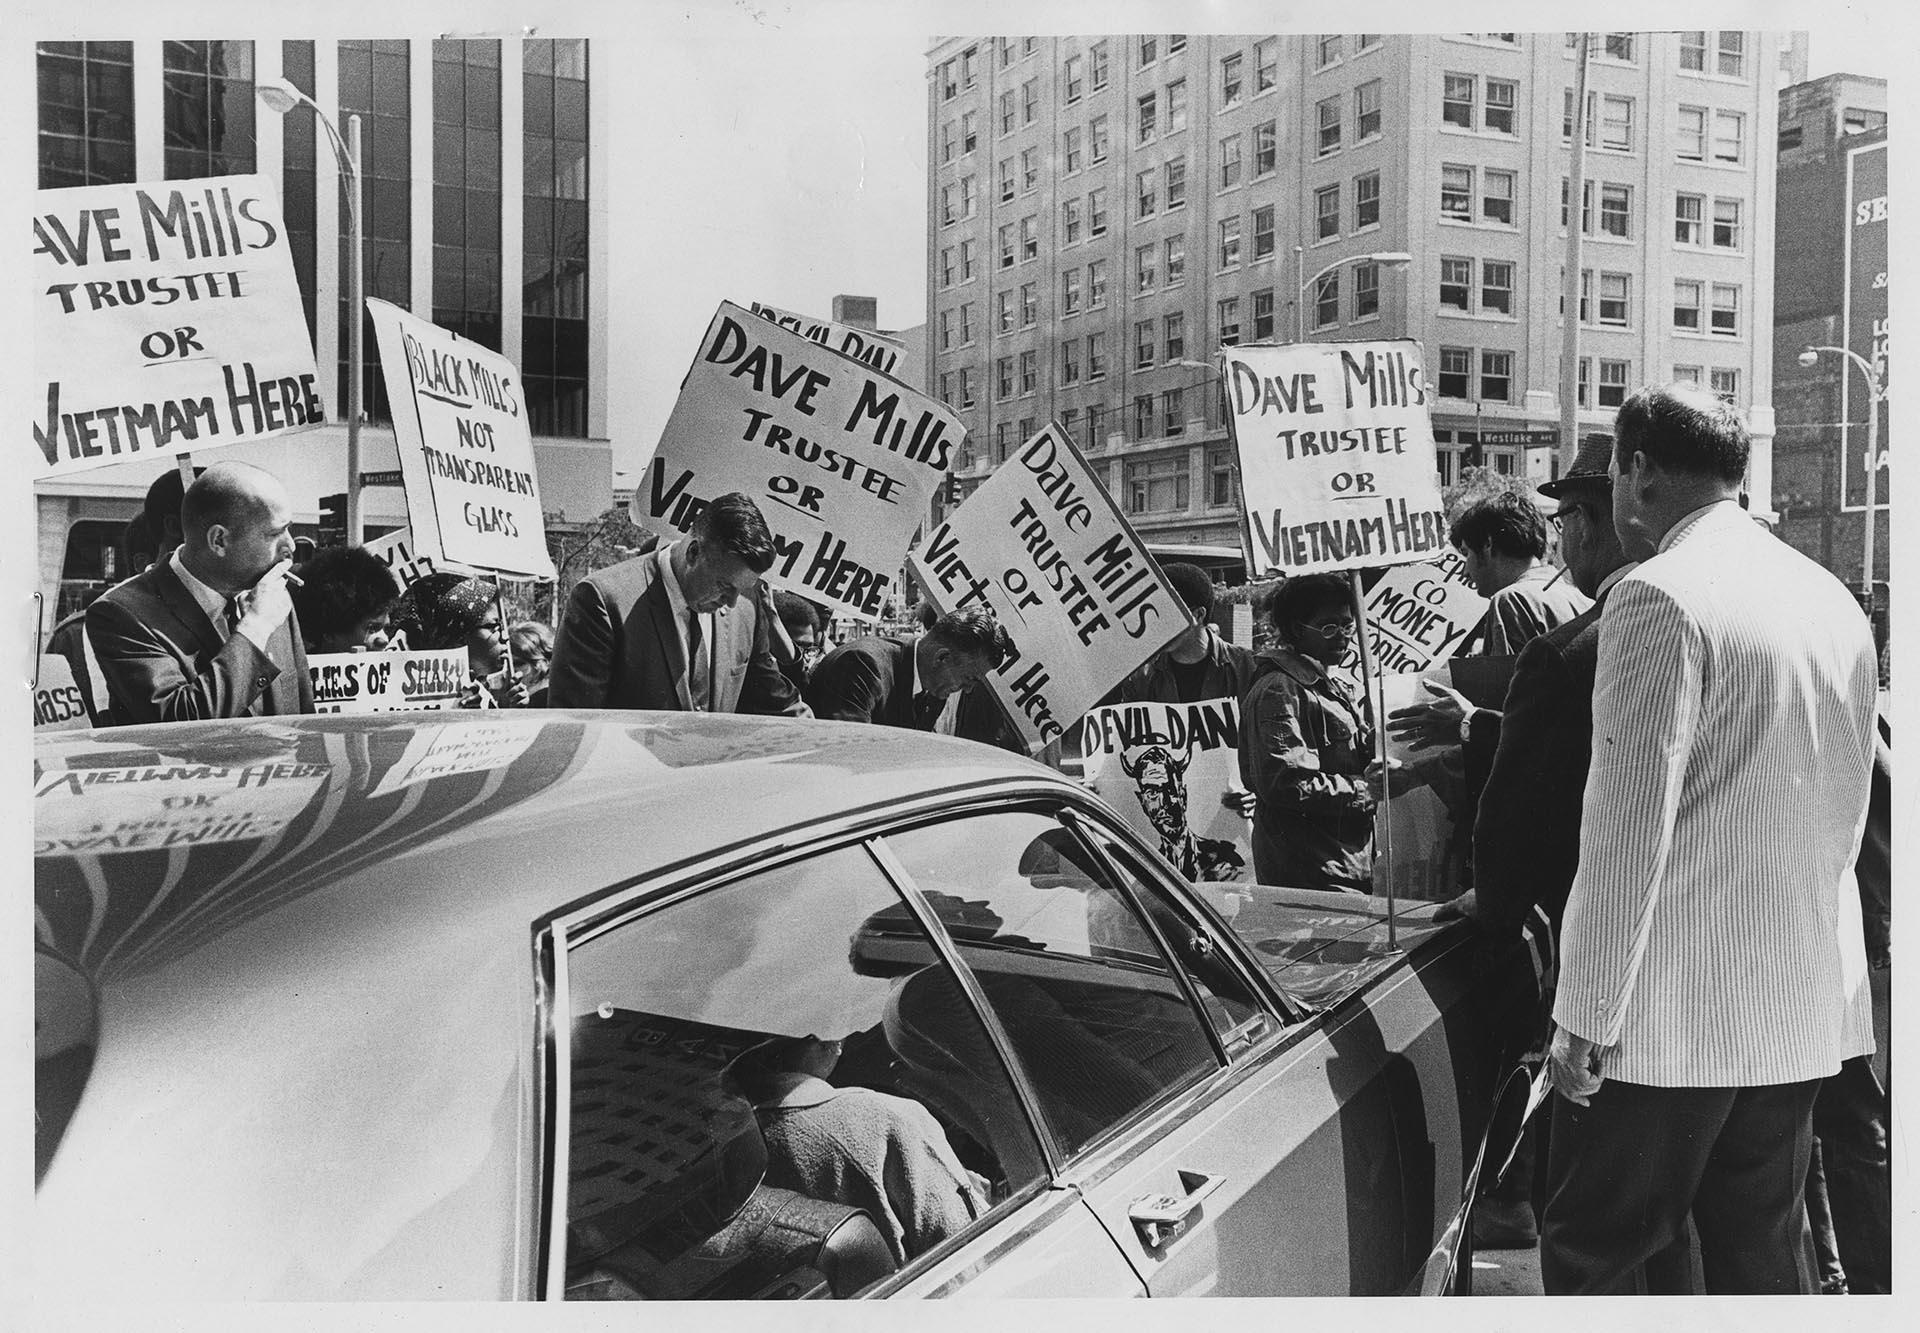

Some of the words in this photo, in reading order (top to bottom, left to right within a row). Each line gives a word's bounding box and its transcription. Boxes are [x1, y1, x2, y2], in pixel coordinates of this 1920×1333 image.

[46, 270, 250, 314] TRUSTEE
[140, 326, 205, 359] OR
[222, 362, 324, 436] HERE
[406, 333, 468, 397] BLACK
[467, 358, 519, 417] MILLS
[705, 316, 830, 416] DAVE
[844, 379, 953, 471] Mills
[1231, 360, 1324, 416] DAVE
[1340, 350, 1425, 409] Mills
[456, 416, 495, 452] NOT
[743, 408, 907, 505] TRUSTEE
[1276, 427, 1408, 460] TRUSTEE
[1484, 433, 1532, 443] Westlake
[420, 446, 535, 497] TRANSPARENT
[767, 475, 825, 513] OR
[1331, 472, 1375, 493] OR
[464, 502, 519, 538] GLASS
[1020, 433, 1092, 536] Dave
[1083, 532, 1159, 639] Mills
[1252, 509, 1386, 567] VIETNAM
[802, 531, 890, 616] HERE
[1009, 497, 1111, 647] TRUSTEE
[1367, 586, 1467, 657] MONEY
[367, 662, 391, 695] OF
[1010, 662, 1063, 745] Here
[1085, 706, 1171, 758] DEVIL
[1165, 702, 1239, 751] DAN
